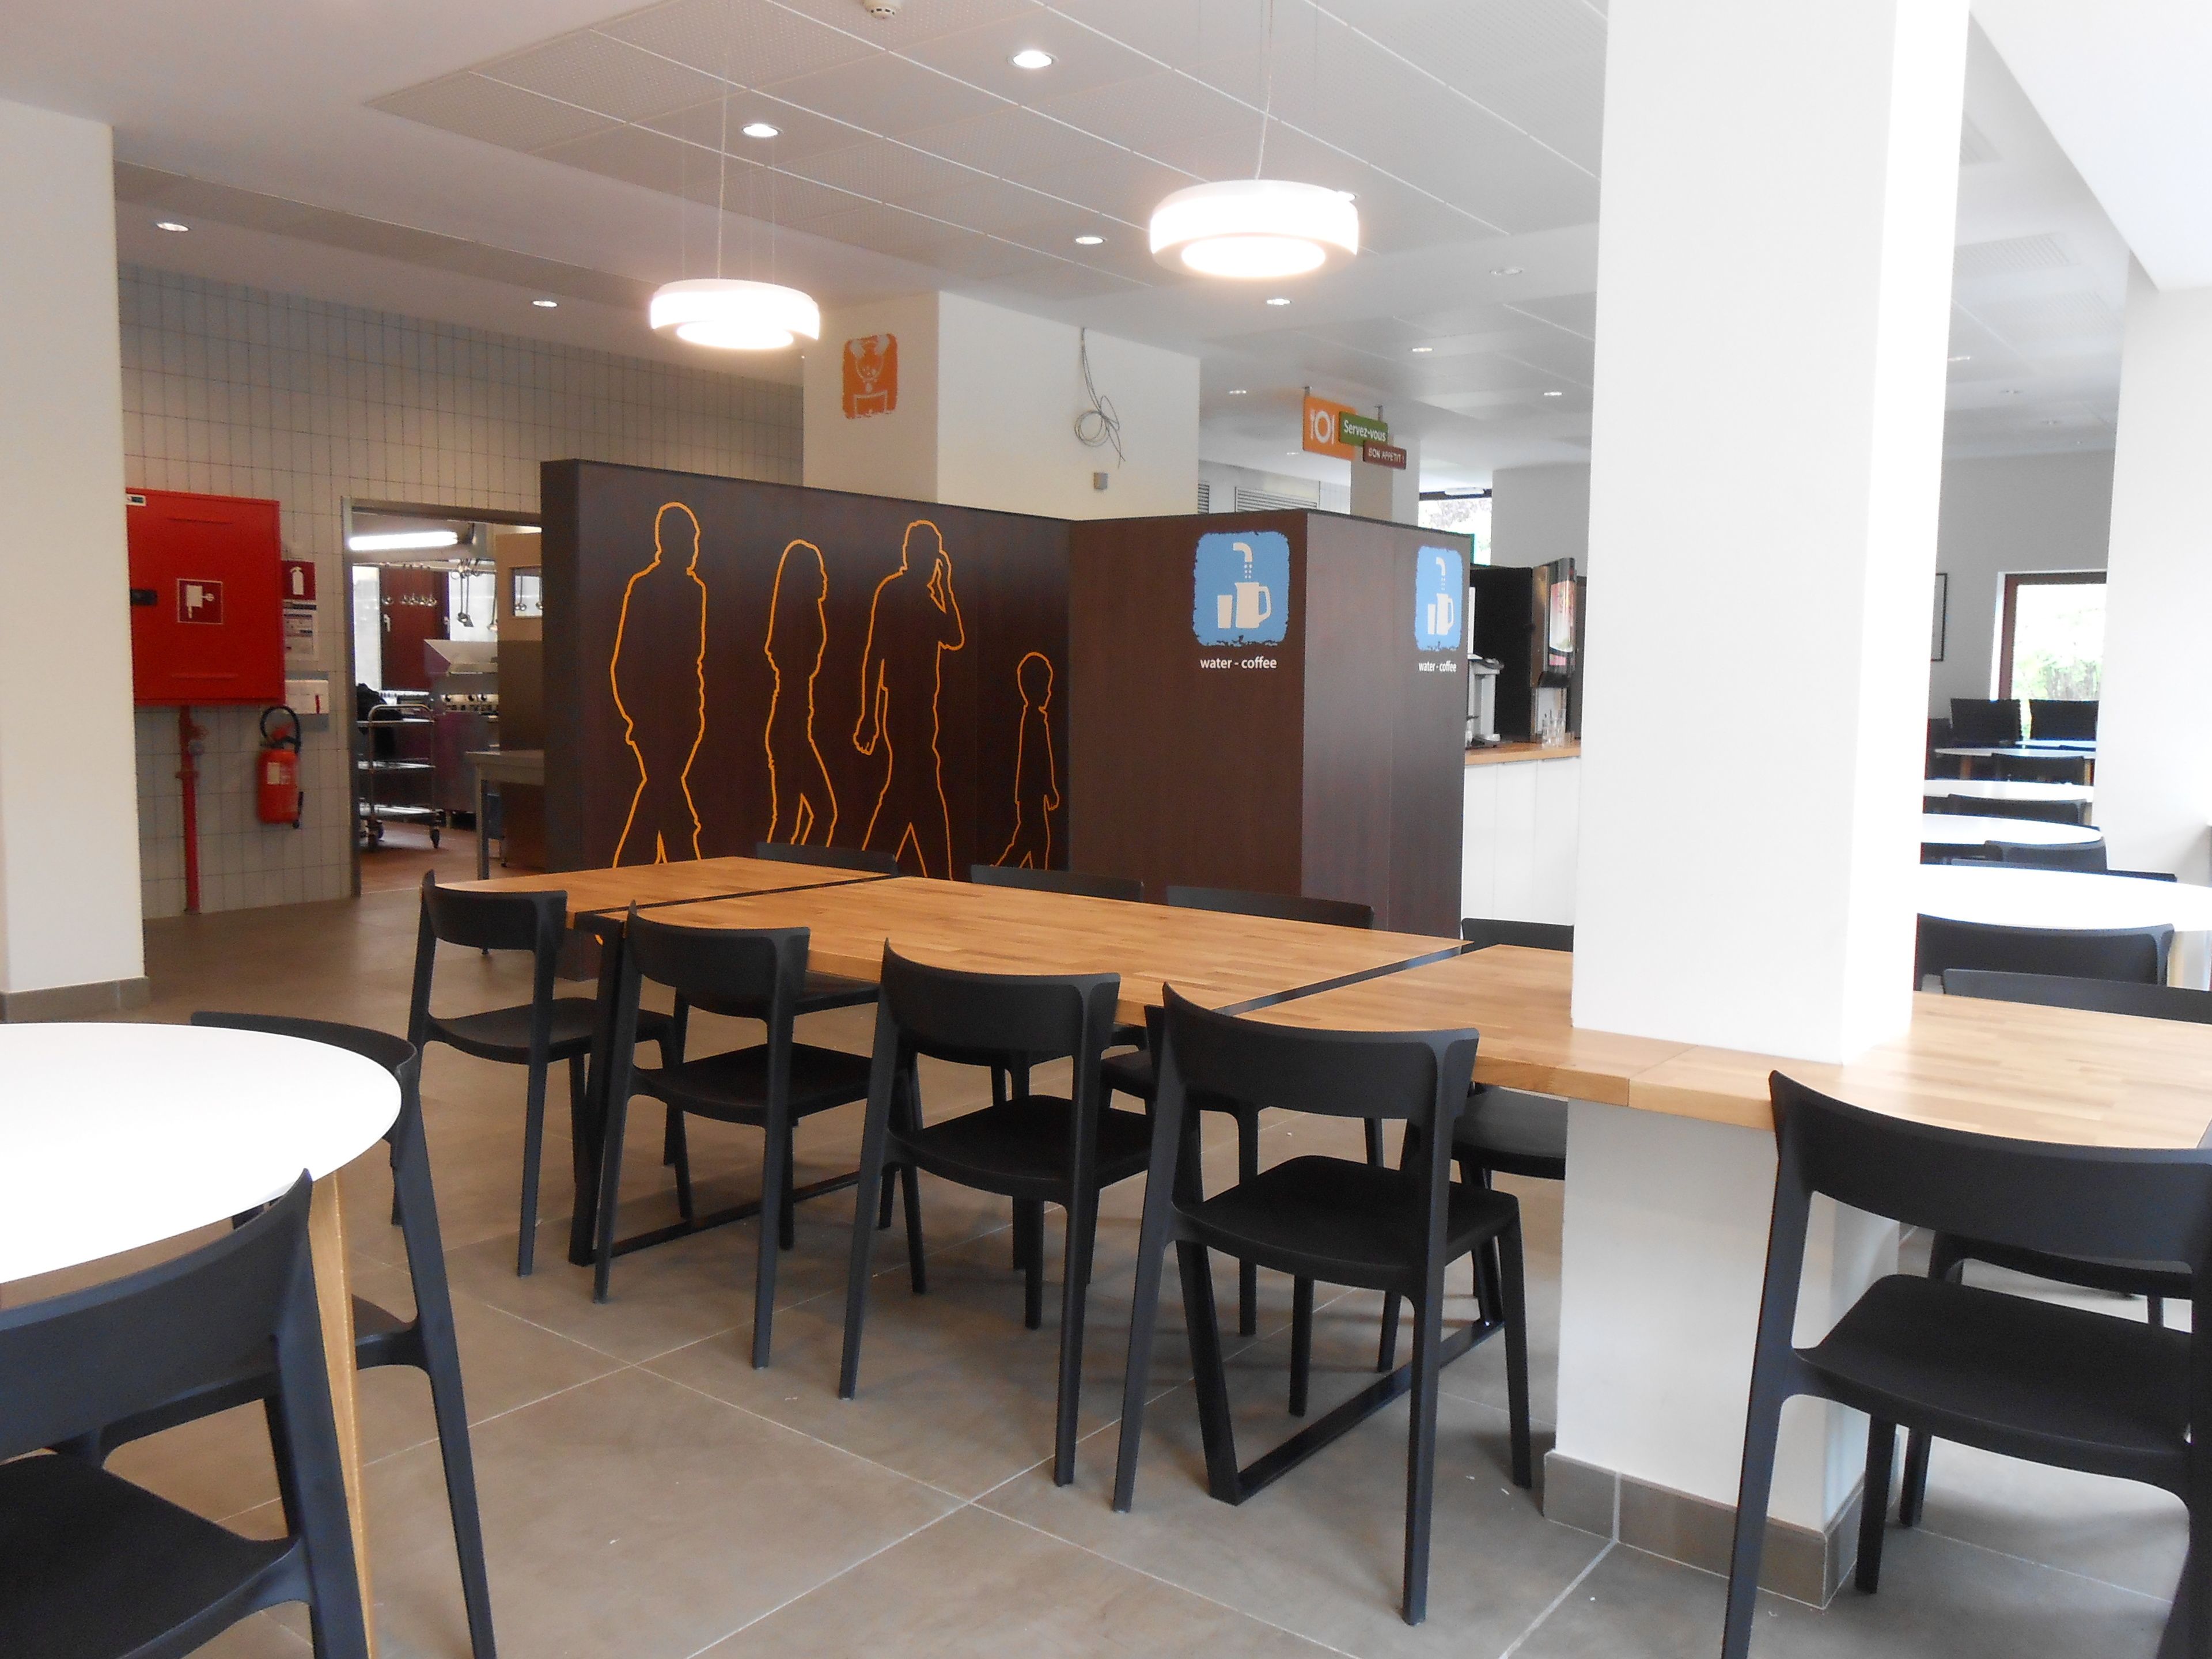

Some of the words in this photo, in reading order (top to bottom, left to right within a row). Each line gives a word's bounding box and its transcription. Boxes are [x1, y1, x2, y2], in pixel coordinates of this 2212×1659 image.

[1344, 419, 1386, 442] Servez-vous
[1368, 448, 1381, 459] BON
[1200, 658, 1233, 669] water
[1241, 656, 1277, 669] coffee
[1419, 661, 1435, 671] water
[1440, 660, 1456, 672] coffee
